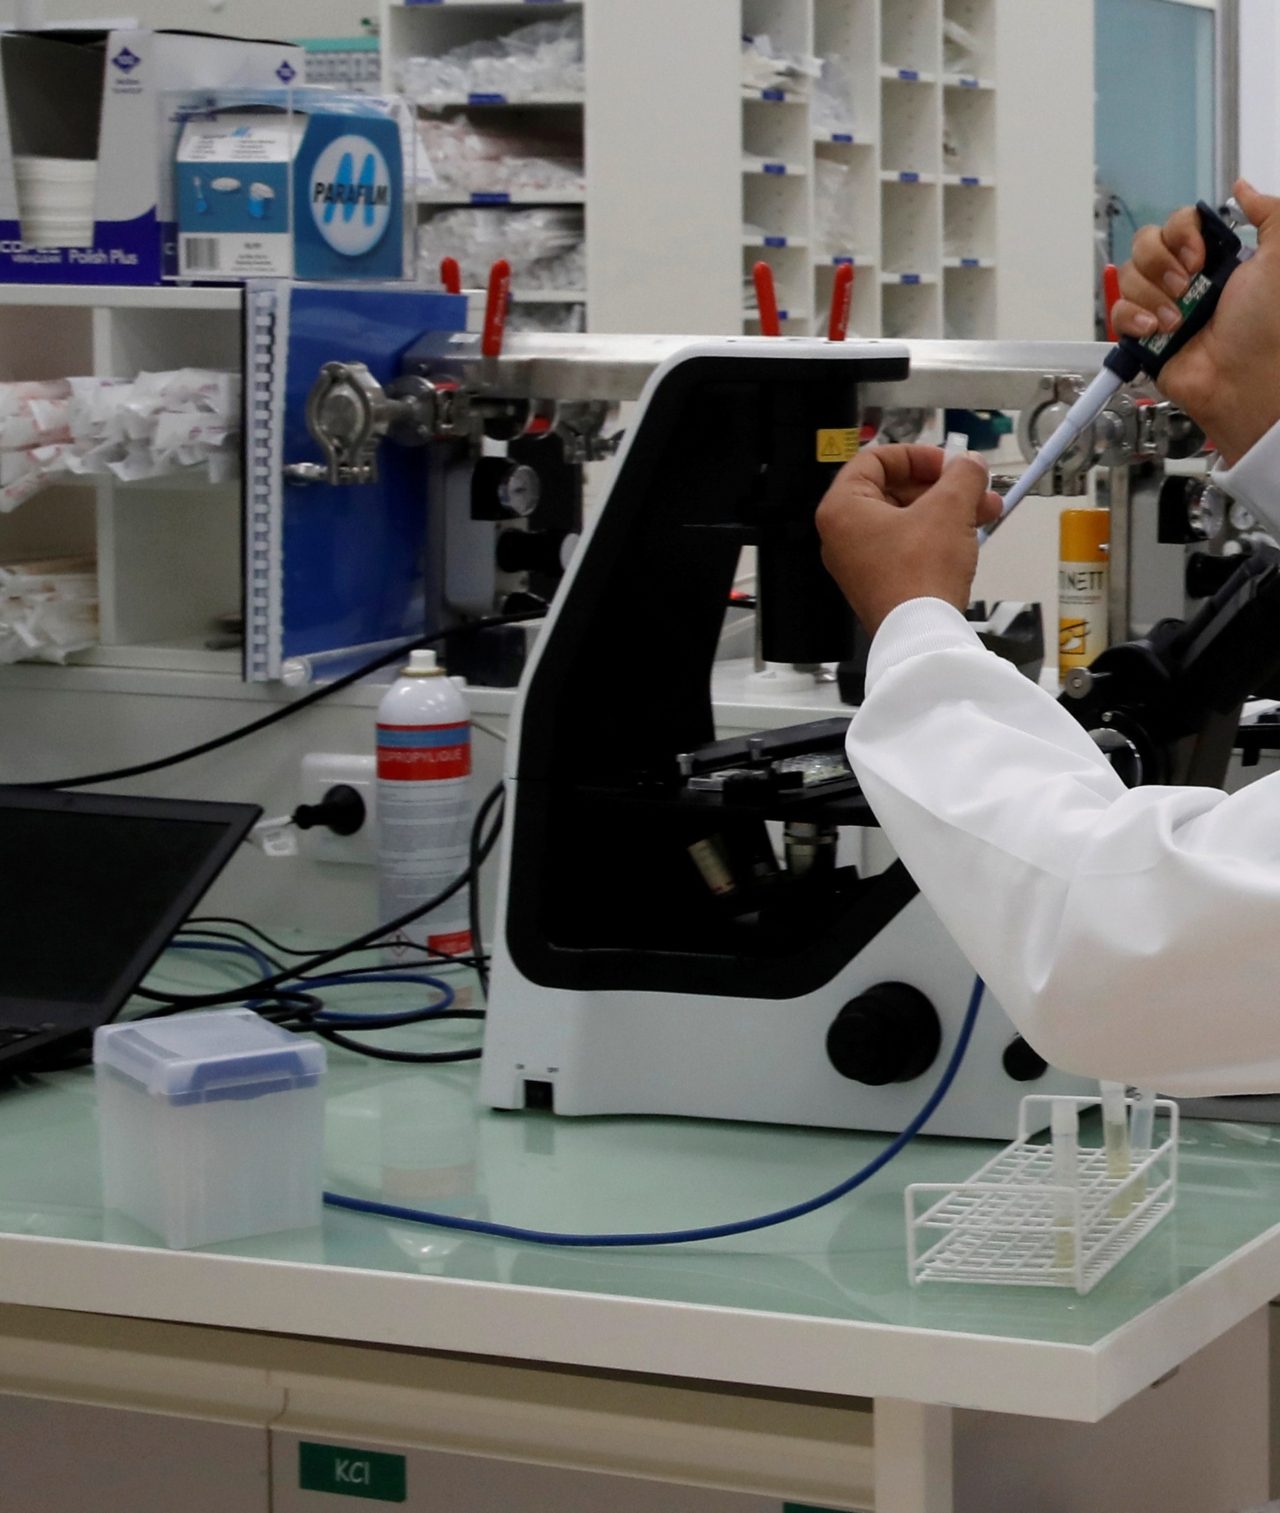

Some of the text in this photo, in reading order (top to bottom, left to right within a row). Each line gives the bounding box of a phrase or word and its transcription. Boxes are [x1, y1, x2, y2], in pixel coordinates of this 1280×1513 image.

[313, 181, 389, 206] PARAFILM
[68, 248, 139, 265] Polish Plus
